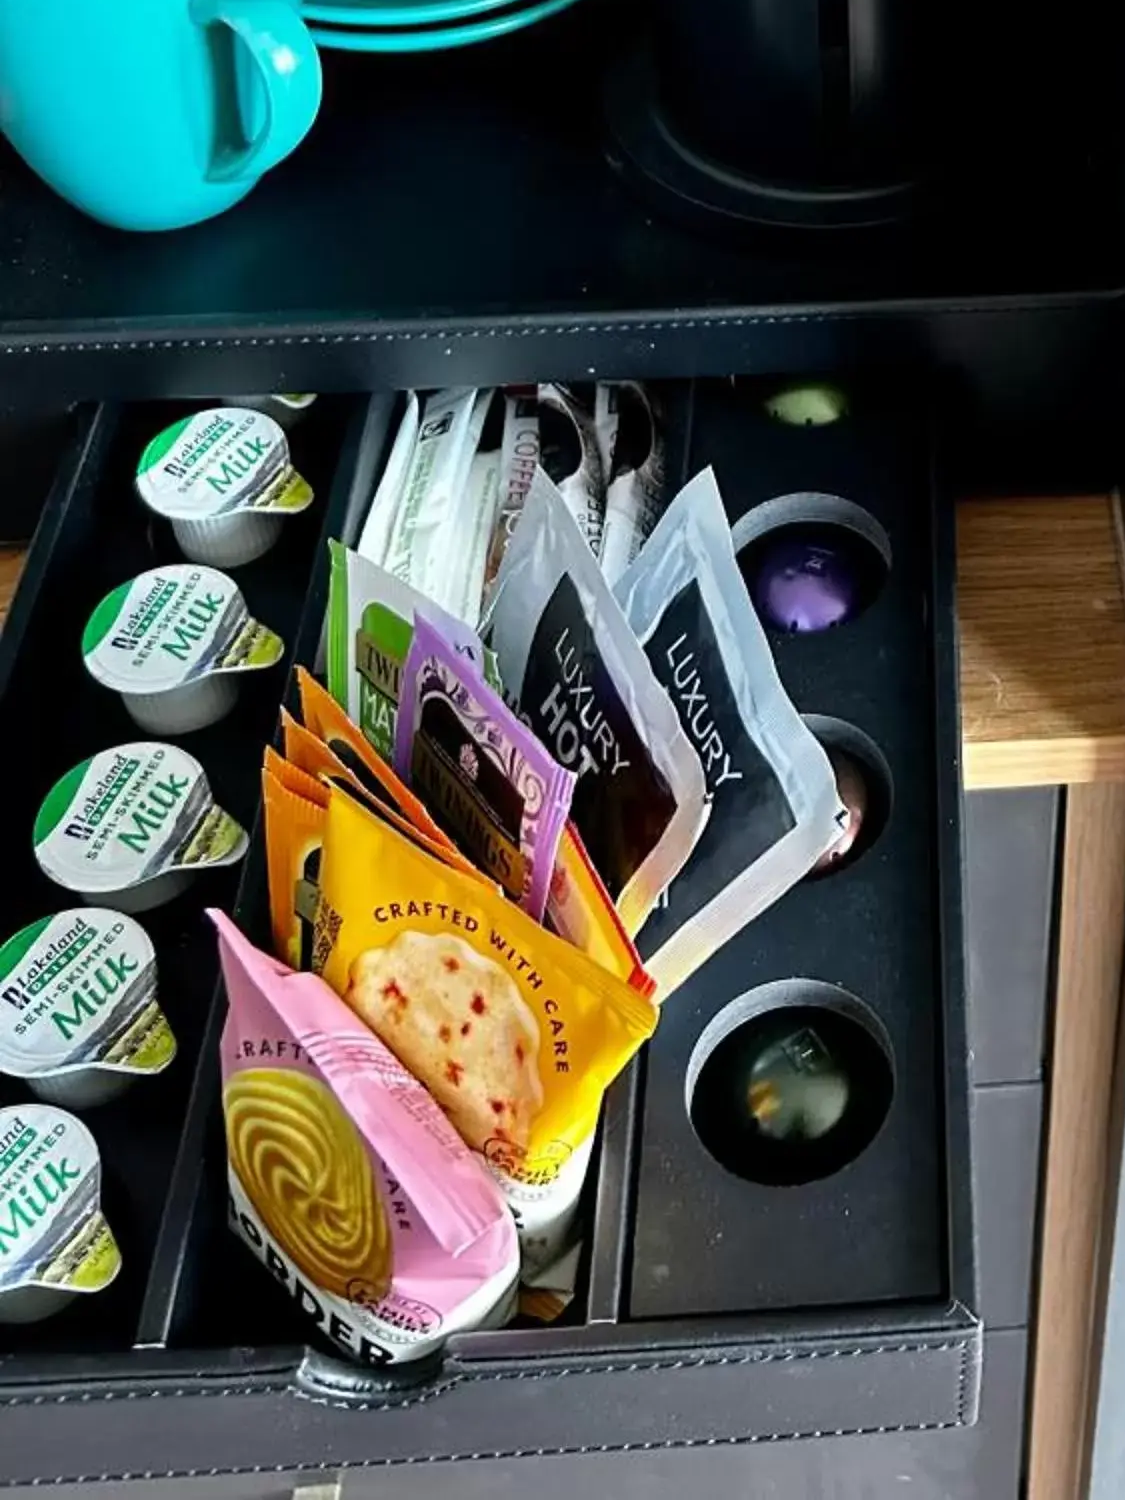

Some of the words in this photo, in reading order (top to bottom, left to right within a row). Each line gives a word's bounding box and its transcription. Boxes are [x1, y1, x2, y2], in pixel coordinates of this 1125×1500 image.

[206, 436, 273, 495] Milk
[124, 576, 166, 636] Lakeland
[131, 572, 201, 667] SEMI-SKIMMED
[160, 592, 225, 661] Milk
[540, 682, 600, 778] HOT
[555, 627, 631, 776] LUXURY
[666, 633, 743, 786] LUXURY
[74, 753, 128, 822] Lakeland
[86, 749, 165, 861] SEMI-SKIMMED
[117, 772, 189, 854] Milk
[15, 922, 125, 1036] SEMI-SKIMMED
[17, 917, 87, 988] Lakeland
[51, 952, 138, 1041] Milk
[373, 900, 479, 932] CRAFTED
[489, 929, 543, 990] WITH
[543, 999, 569, 1073] CARE
[0, 1157, 80, 1255] Milk
[229, 1200, 395, 1366] ORDER
